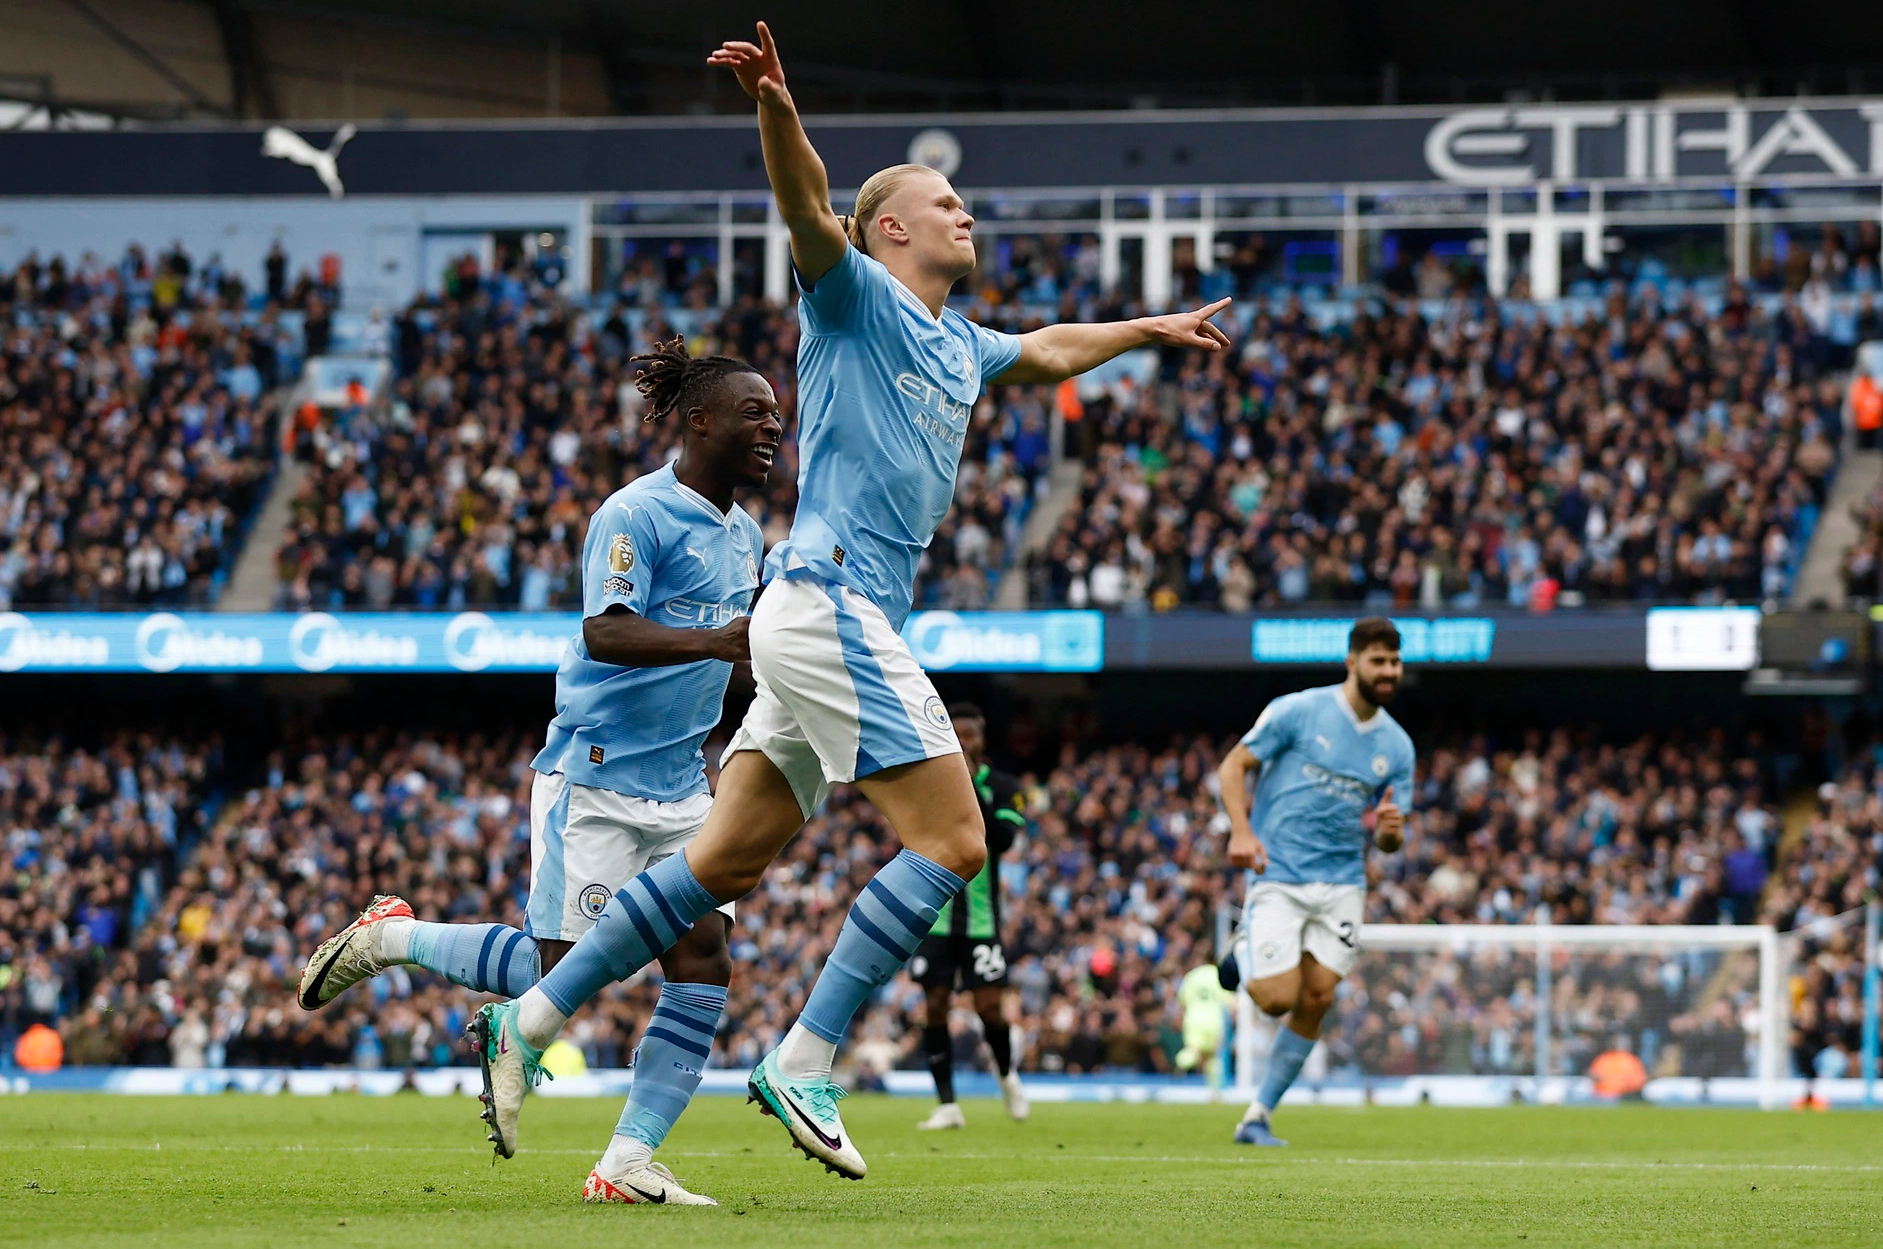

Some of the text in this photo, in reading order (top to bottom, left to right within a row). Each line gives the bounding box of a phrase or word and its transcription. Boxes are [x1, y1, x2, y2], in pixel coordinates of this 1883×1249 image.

[895, 372, 969, 428] ETIHA
[913, 411, 962, 448] AIRWAY
[664, 597, 749, 622] ETIHA
[673, 1061, 703, 1079] CIT
